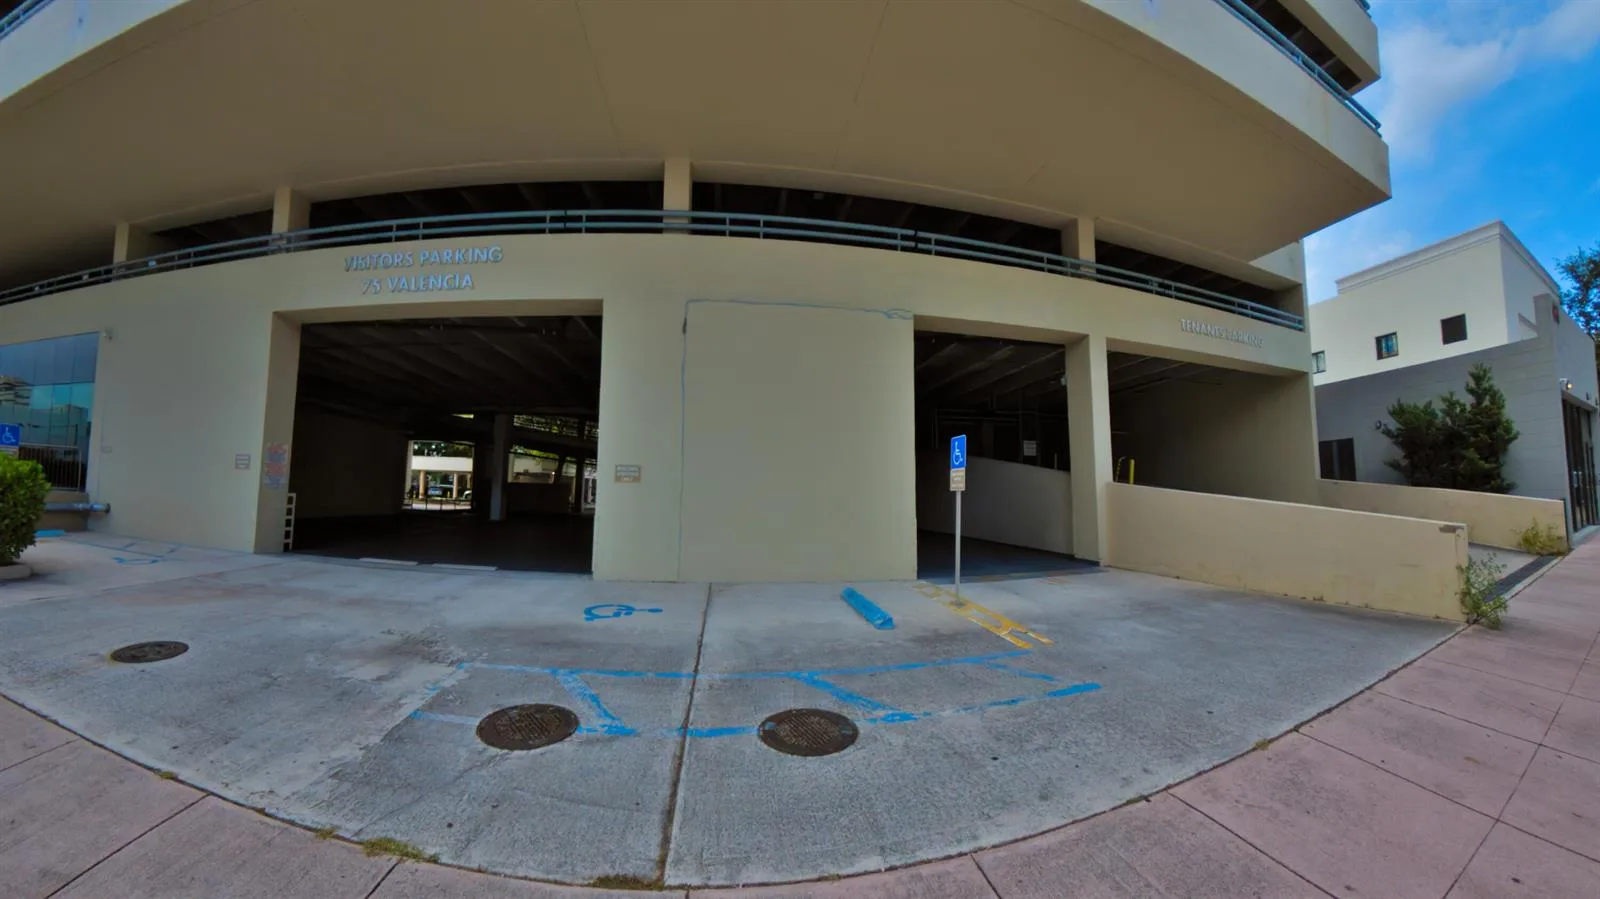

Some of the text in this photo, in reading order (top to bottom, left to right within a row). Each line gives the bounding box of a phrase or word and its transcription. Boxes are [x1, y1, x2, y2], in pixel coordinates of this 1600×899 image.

[344, 246, 503, 272] VISITORS PARKING
[362, 273, 474, 295] 75 VALENCIA
[1180, 318, 1224, 339] TENANTS
